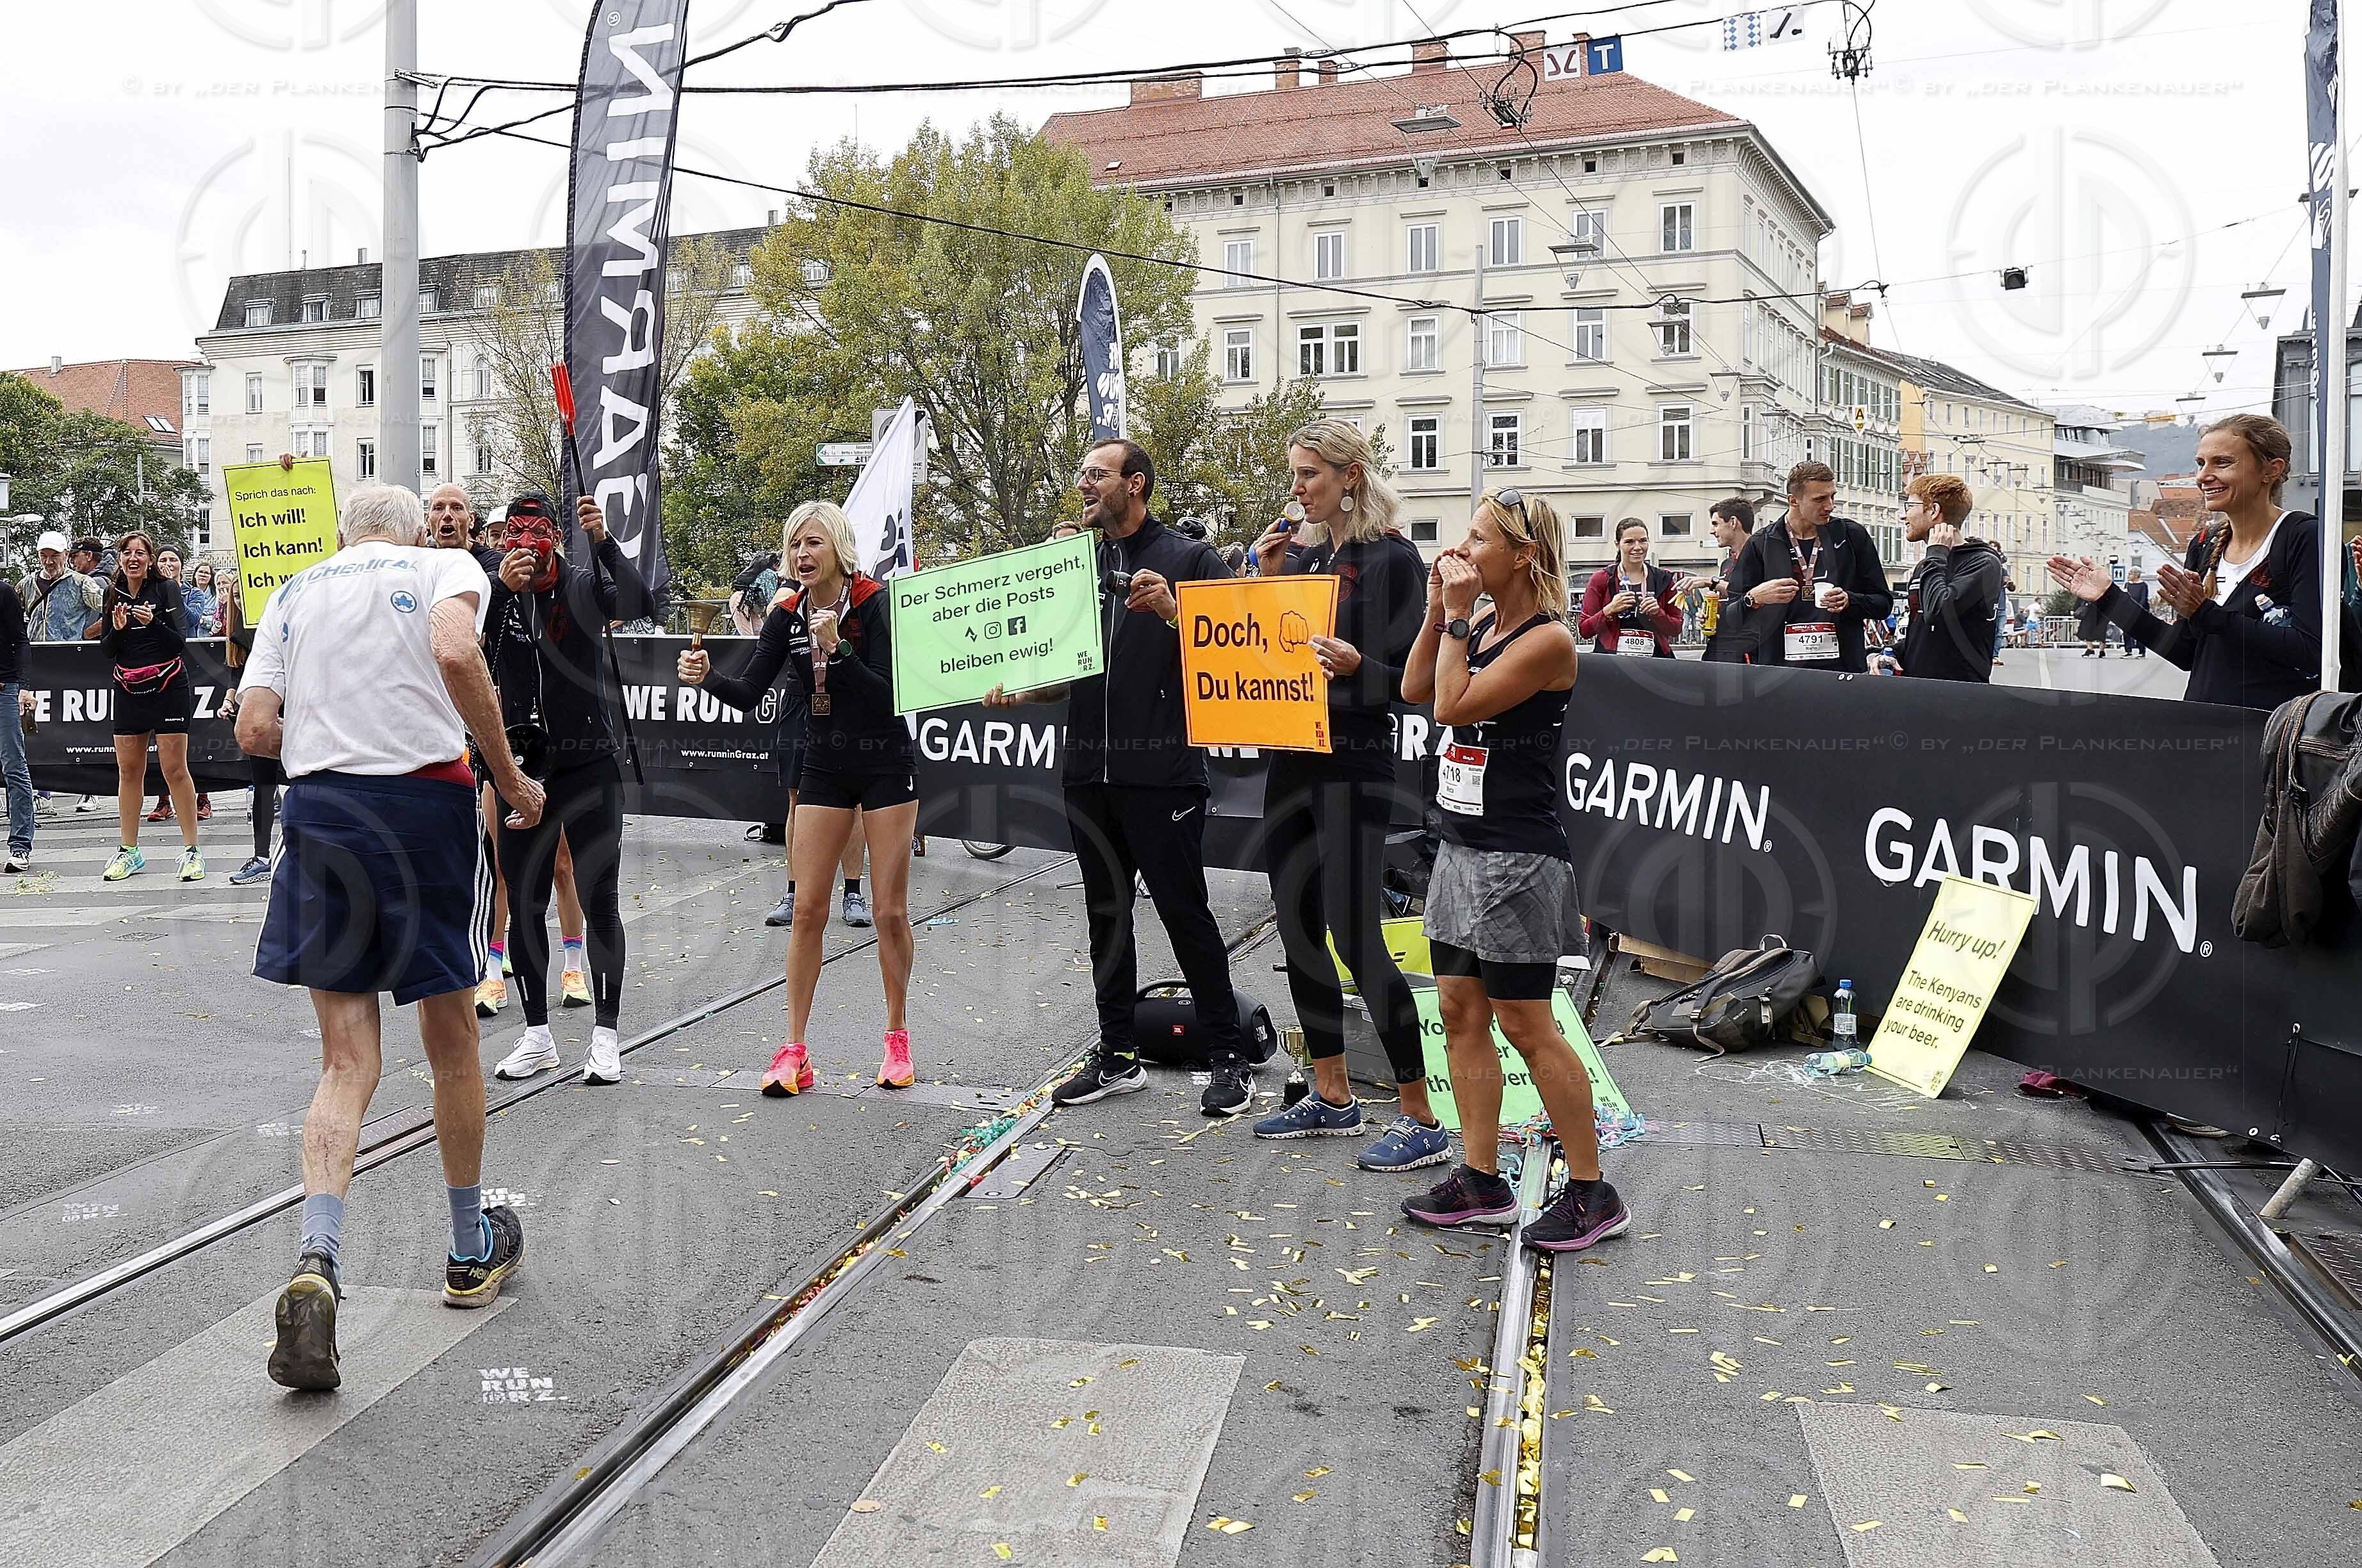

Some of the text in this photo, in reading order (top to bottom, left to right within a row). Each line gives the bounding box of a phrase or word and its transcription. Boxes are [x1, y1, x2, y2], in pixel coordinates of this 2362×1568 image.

[235, 486, 316, 502] Sprich das nach:
[239, 508, 306, 528] Ich will!
[243, 537, 323, 558] Ich kann!
[247, 572, 274, 588] Ich
[901, 555, 1085, 608] Der Schmerz vergeht,
[932, 586, 1054, 623] aber die Posts
[1193, 612, 1268, 653] Doch,
[1798, 635, 1823, 644] 4791
[940, 637, 1054, 674] bleiben ewig!
[1077, 650, 1088, 658] WE
[1078, 657, 1092, 666] RUN
[1197, 671, 1314, 701] Du kannst!
[62, 689, 114, 722] RU
[622, 685, 667, 721] WE
[680, 749, 769, 760] www.runninGraz.at
[919, 717, 1067, 769] GARM
[1566, 753, 1769, 851] GARMIN
[1865, 807, 2197, 953] GARMIN
[1928, 920, 2006, 960] Hurry up!
[1907, 970, 1983, 1008] The Kenyans
[1896, 996, 1965, 1033] are drinking
[1883, 1018, 1938, 1049] your beer.
[1426, 1075, 1451, 1093] th
[478, 1367, 530, 1379] WE
[480, 1377, 554, 1391] RUN
